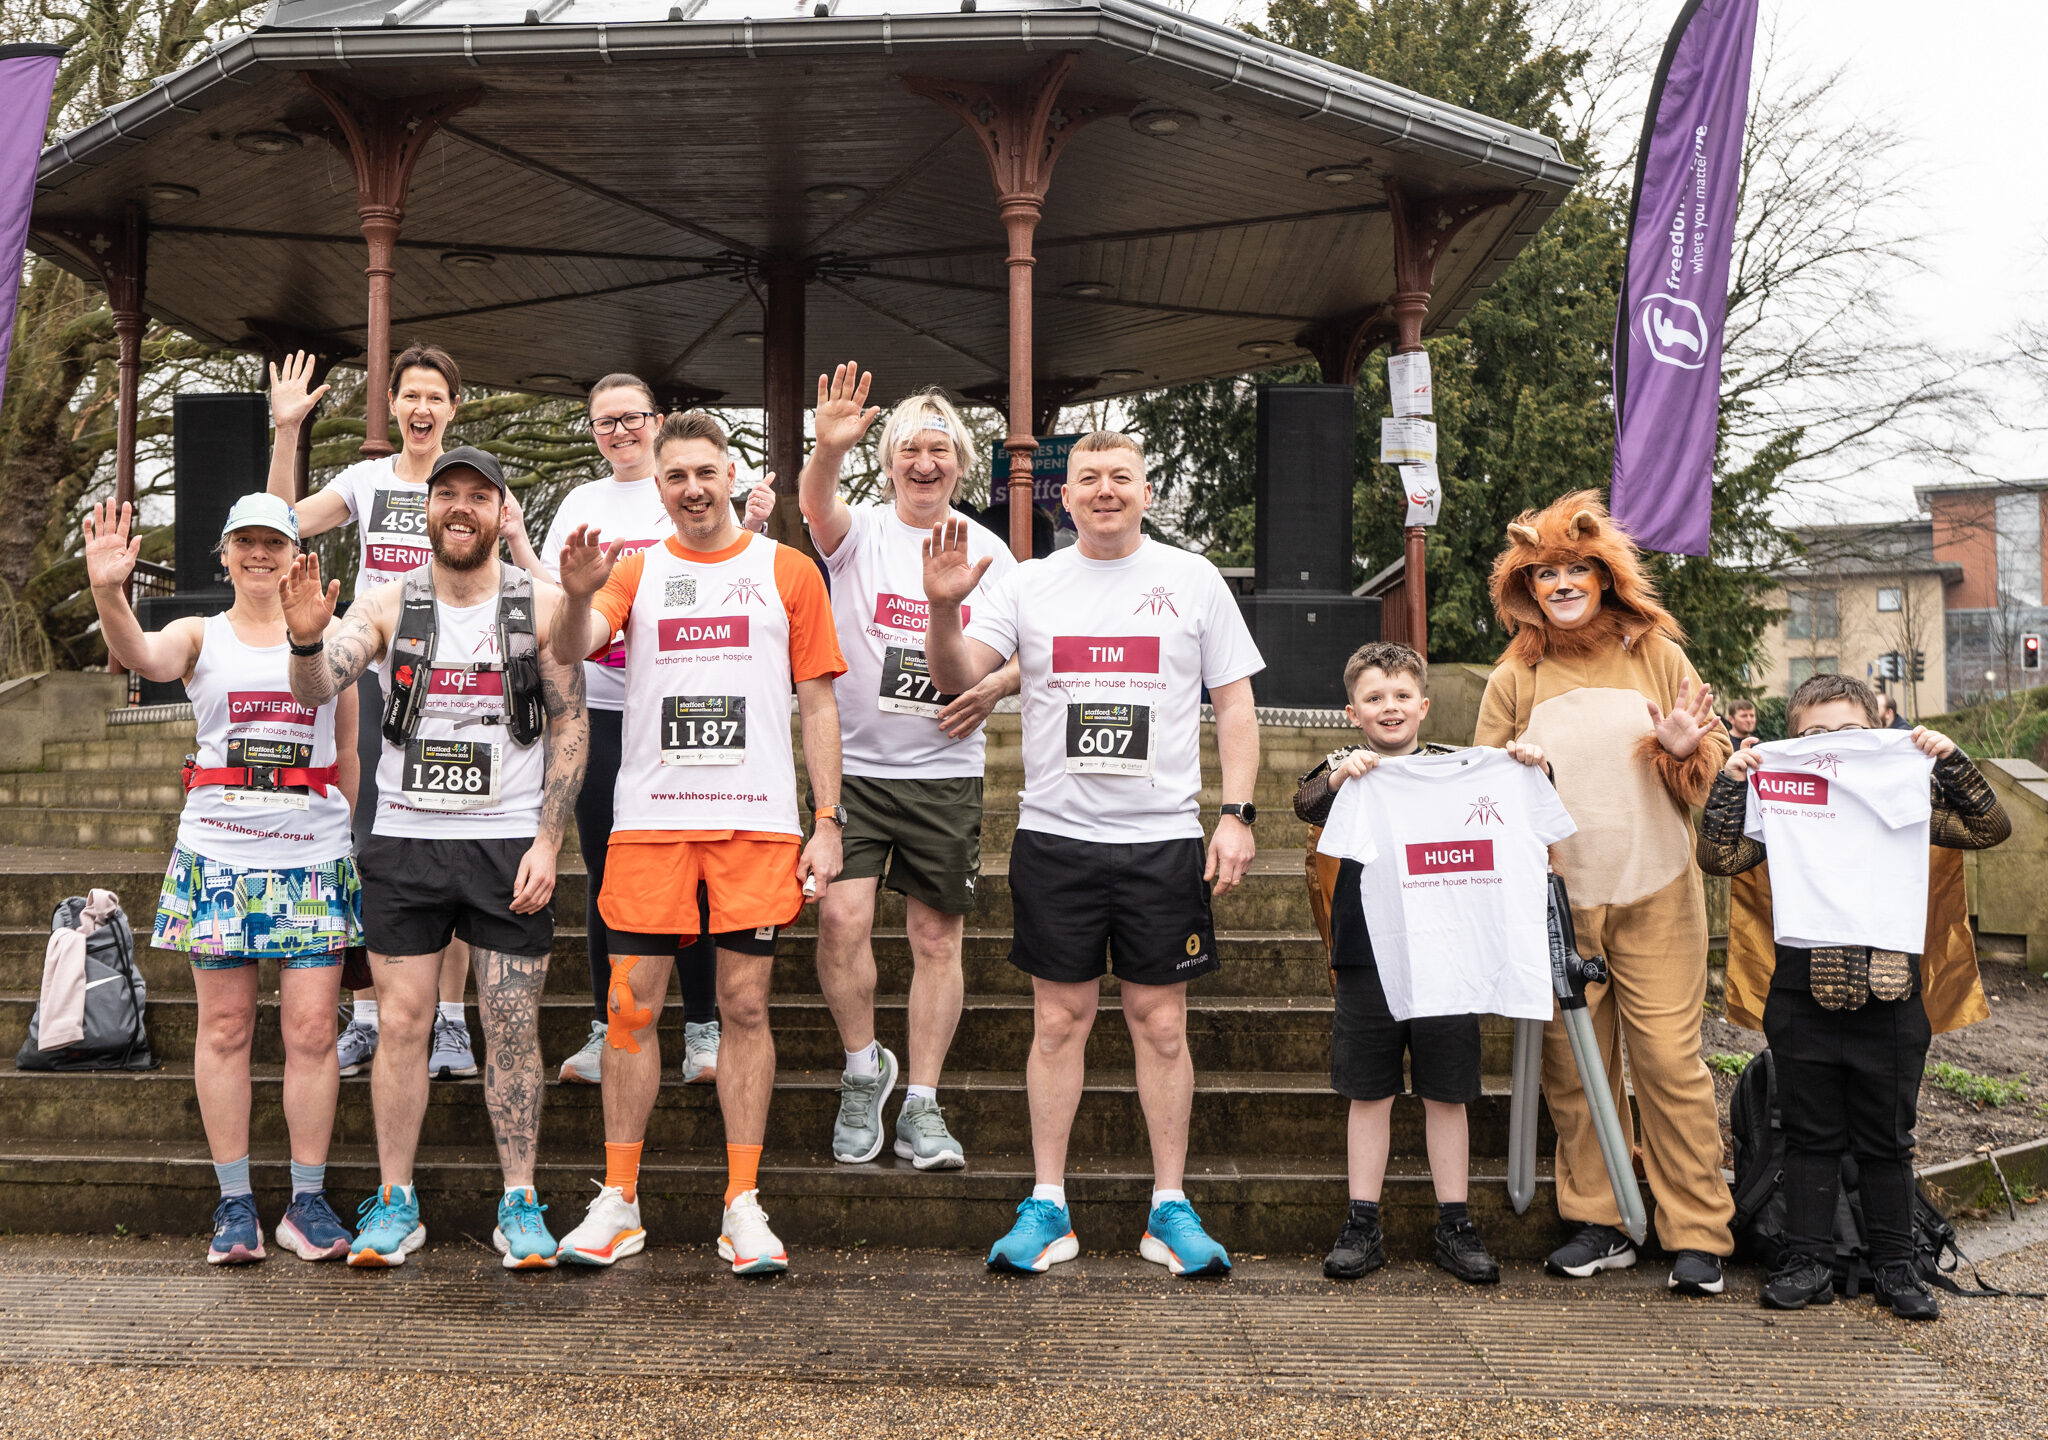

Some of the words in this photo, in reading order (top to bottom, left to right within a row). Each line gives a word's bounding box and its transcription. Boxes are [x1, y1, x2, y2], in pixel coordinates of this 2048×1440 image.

[1696, 155, 1707, 199] matter
[1694, 203, 1709, 227] you
[1666, 203, 1685, 291] freedo
[1690, 231, 1704, 275] where
[380, 511, 428, 534] 459
[886, 597, 930, 615] ANDRE
[675, 625, 731, 642] ADAM
[865, 626, 908, 643] katharine
[655, 653, 693, 665] katharine
[696, 651, 720, 662] house
[723, 651, 753, 663] hospice
[1088, 646, 1124, 663] TIM
[439, 672, 478, 687] JOE
[1046, 678, 1091, 689] katharine
[1094, 678, 1126, 688] house
[1130, 678, 1167, 691] hospice
[450, 699, 475, 709] house
[477, 700, 505, 710] hospice
[262, 726, 287, 736] house
[668, 720, 739, 747] 1187
[248, 745, 275, 754] stafford
[425, 745, 451, 753] stafford
[1078, 728, 1133, 755] 607
[411, 764, 483, 792] 1288
[1758, 778, 1815, 796] AURIE
[650, 791, 768, 802] www.khhospice.org.uk
[1770, 806, 1798, 816] house
[1801, 808, 1836, 820] hospice
[199, 816, 315, 841] www.khhospice.org.uk
[1424, 848, 1475, 866] HUGH
[1402, 880, 1440, 889] katharine
[1442, 877, 1468, 887] house
[1470, 876, 1503, 886] hospice
